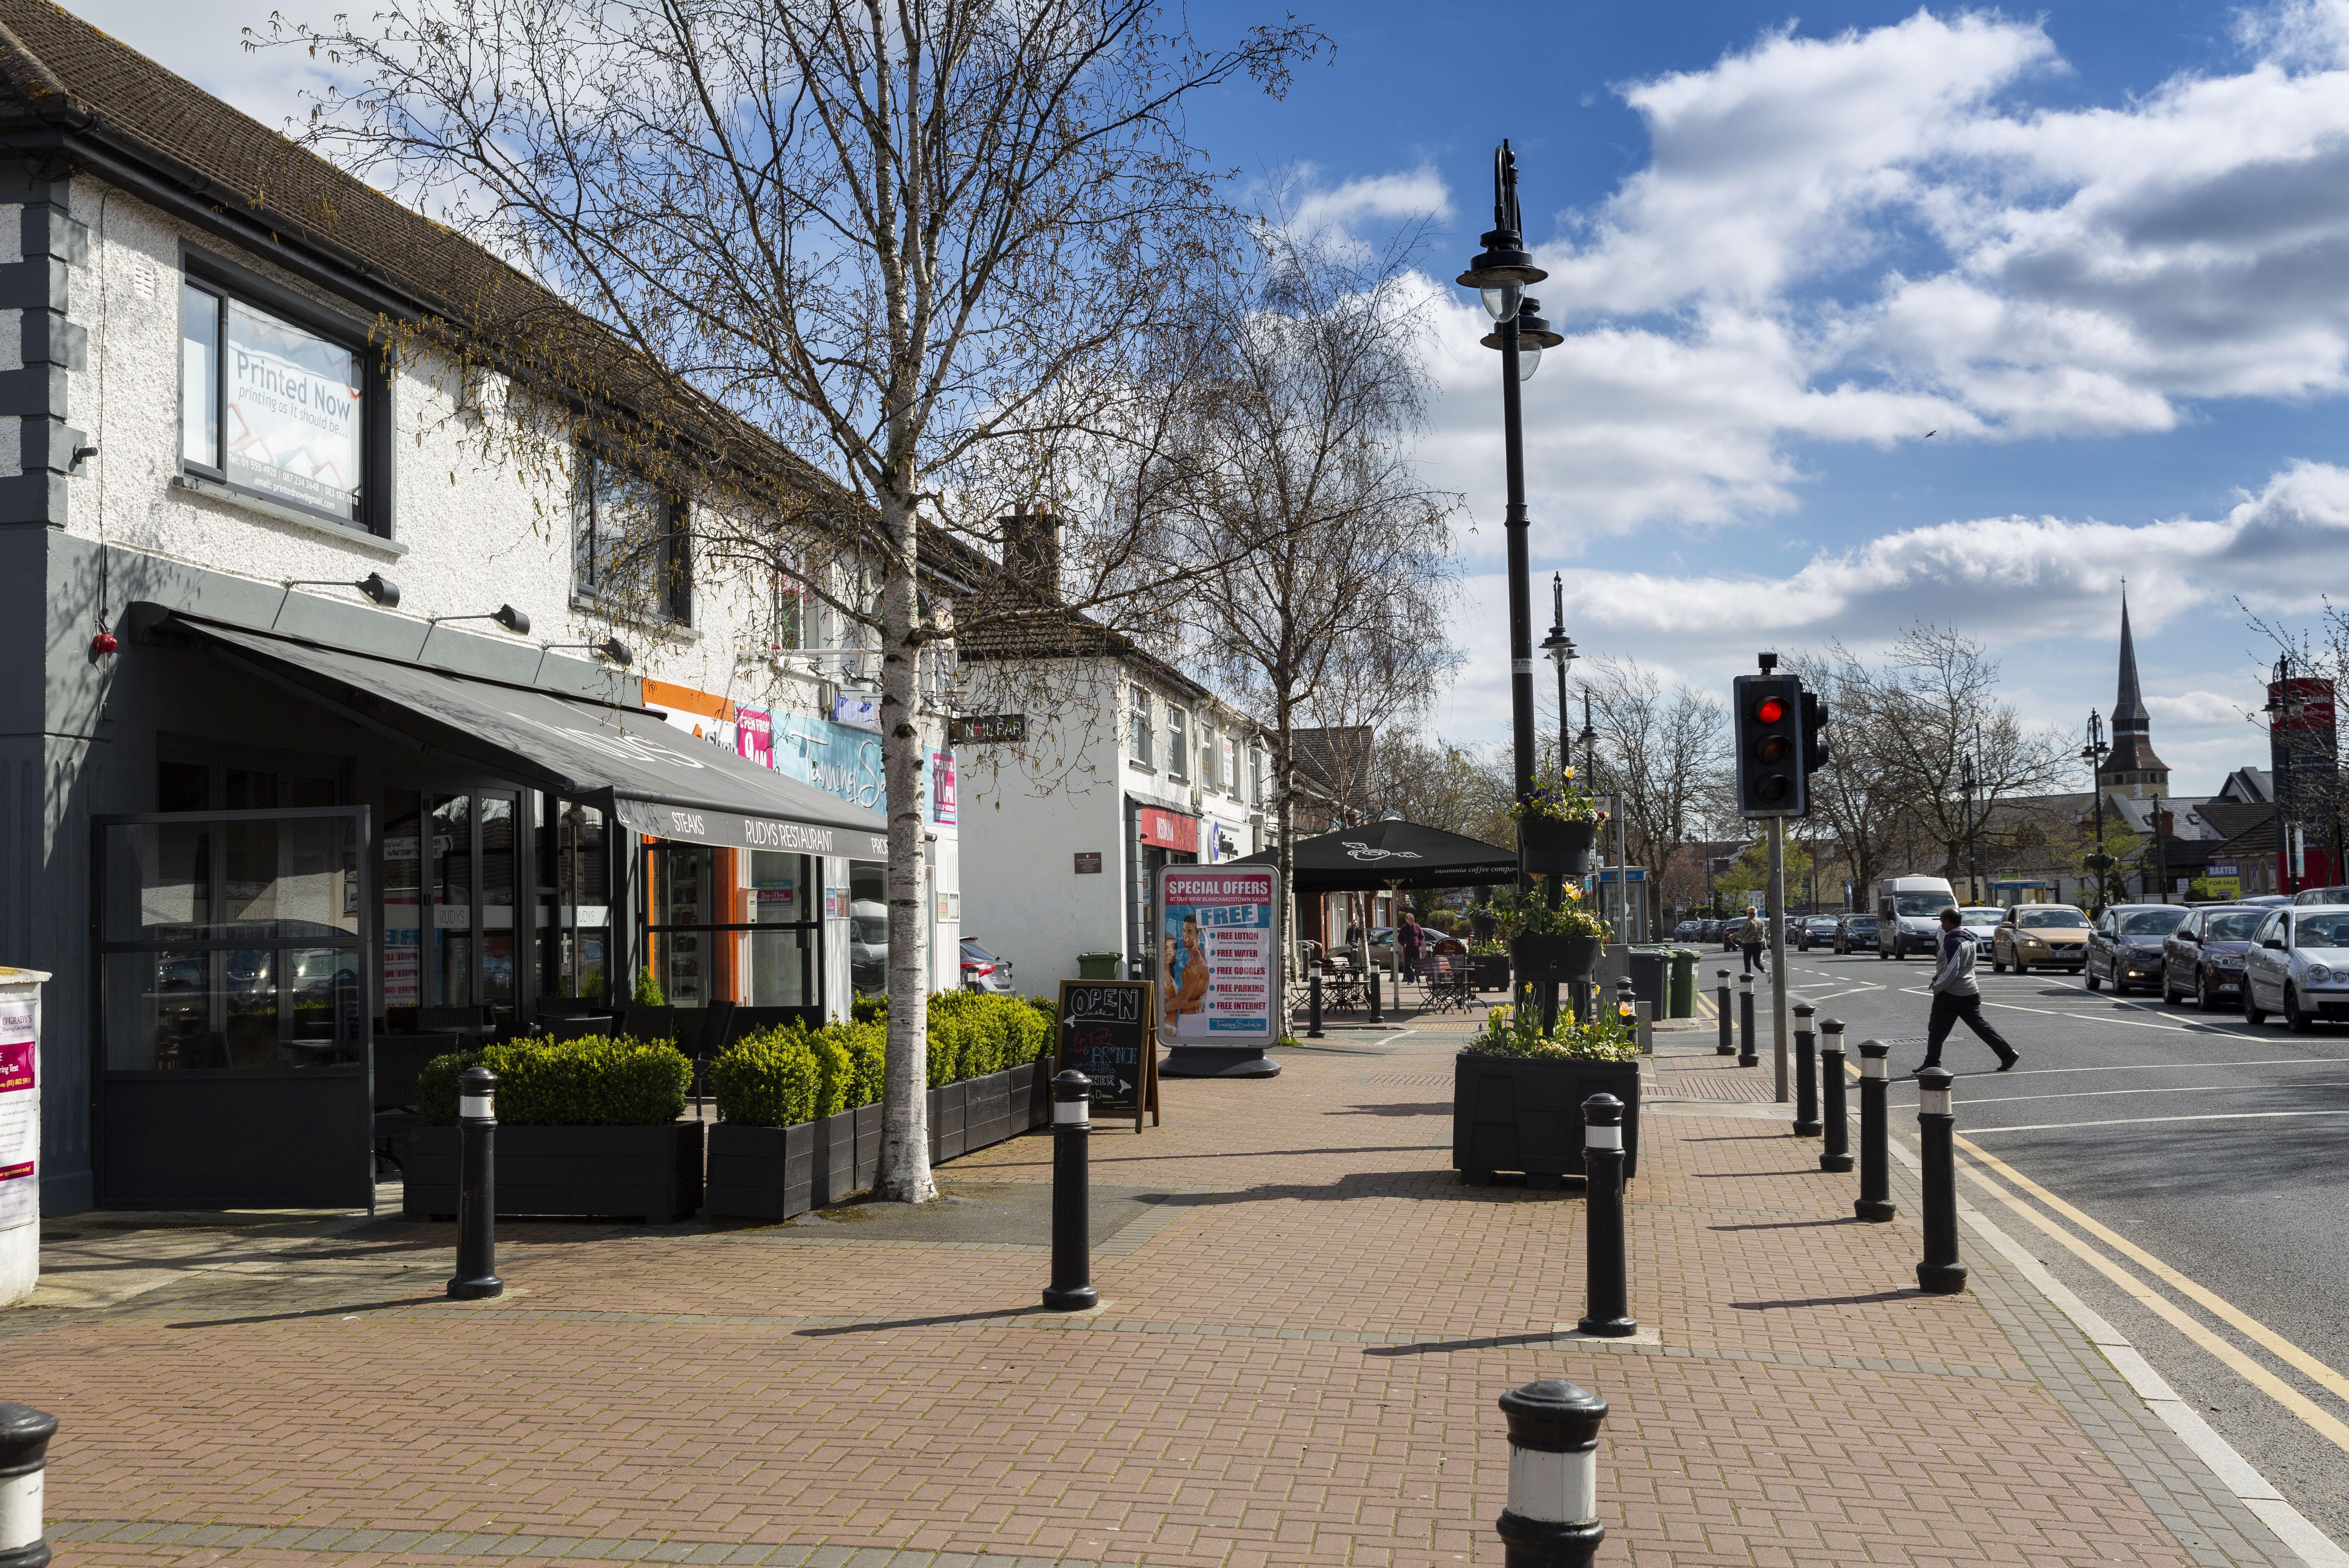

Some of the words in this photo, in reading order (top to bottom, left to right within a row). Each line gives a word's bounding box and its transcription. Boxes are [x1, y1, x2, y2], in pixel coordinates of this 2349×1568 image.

[237, 351, 307, 405] Printed
[315, 382, 350, 421] Now
[239, 386, 276, 412] printing
[279, 402, 287, 414] as
[291, 403, 298, 418] it
[300, 408, 327, 430] should
[330, 418, 347, 438] be...
[228, 454, 239, 466] Tel:
[241, 459, 249, 468] 01
[251, 461, 261, 472] 555
[263, 464, 277, 477] 4920
[283, 472, 293, 482] 087
[294, 475, 304, 487] 234
[306, 479, 319, 492] 3648
[325, 486, 334, 497] 083
[336, 489, 345, 501] 187
[346, 492, 358, 506] 7818
[255, 477, 272, 490] email:
[274, 483, 335, 510] printednow@gmail.com
[740, 715, 756, 731] OPEN
[756, 719, 770, 734] FROM
[789, 730, 858, 805] Tanning
[934, 759, 944, 771] OPEN
[944, 761, 954, 772] UNTIL
[671, 811, 704, 835] STEAKS
[1157, 817, 1174, 842] INSOMNIA
[745, 819, 778, 846] RUDYS
[779, 824, 832, 852] RESTAURANT
[2210, 866, 2237, 875] BAXTER
[1169, 881, 1220, 894] SPECIAL
[1223, 881, 1268, 894] OFFERS
[439, 910, 465, 924] RUDYS
[1201, 905, 1254, 926] FREE
[1071, 989, 1138, 1020] OPEN
[3, 1014, 32, 1025] O'GRADY'S
[1091, 1046, 1138, 1064] BRUNCH
[0, 1065, 9, 1075] ring
[9, 1064, 19, 1072] Test
